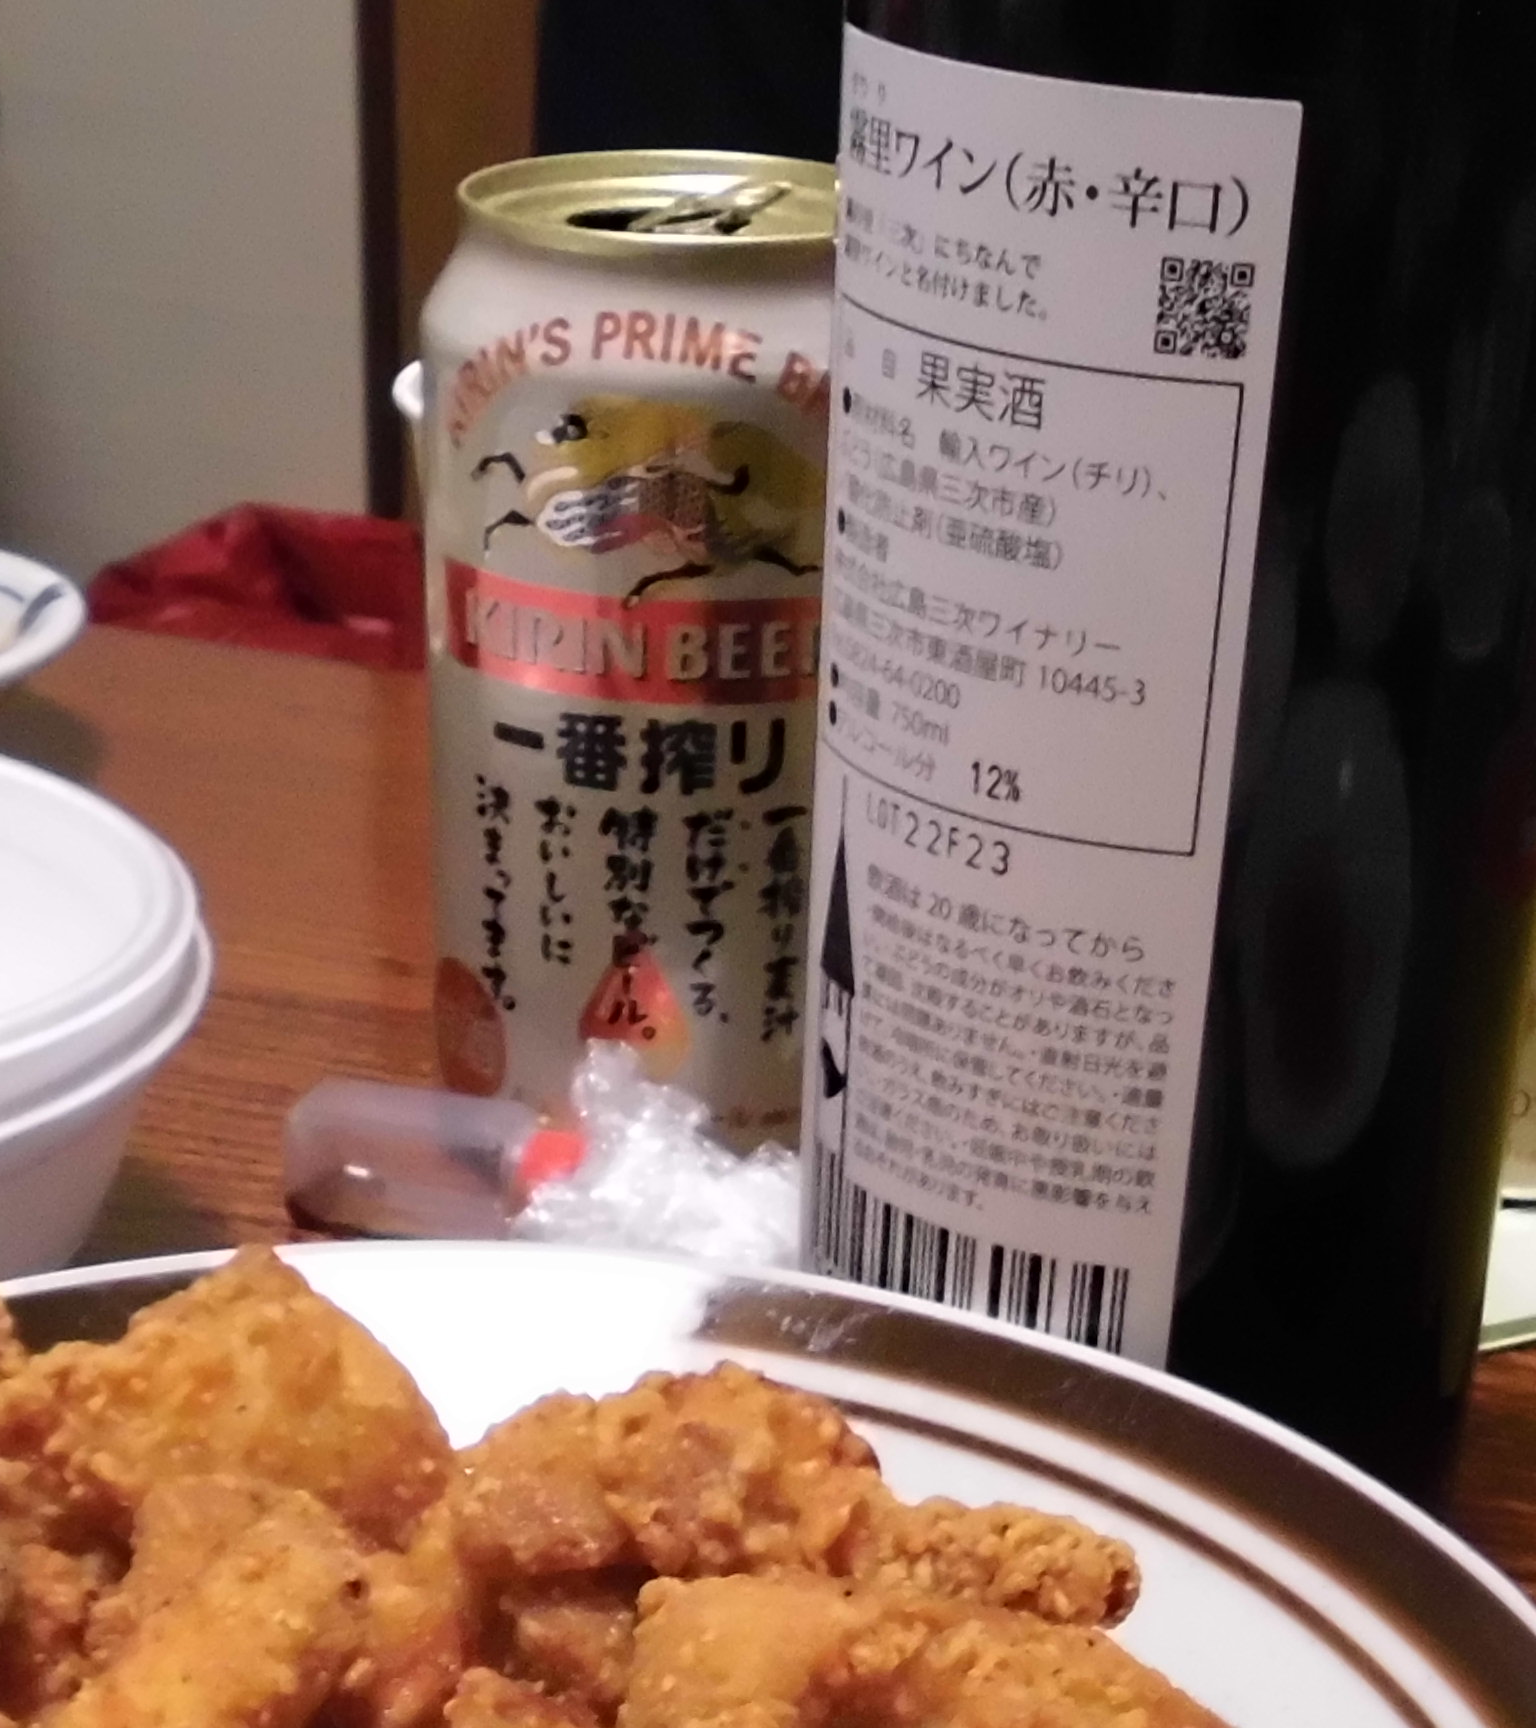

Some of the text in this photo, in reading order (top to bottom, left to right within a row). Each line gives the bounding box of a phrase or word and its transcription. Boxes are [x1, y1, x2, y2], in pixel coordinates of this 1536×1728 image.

[591, 309, 763, 383] PRIME
[916, 350, 1047, 430] 果実酒
[467, 595, 647, 680] KIRIN
[1038, 664, 1145, 706] 10445-3
[493, 712, 785, 795] 一番搾り
[971, 761, 1021, 802] 12%
